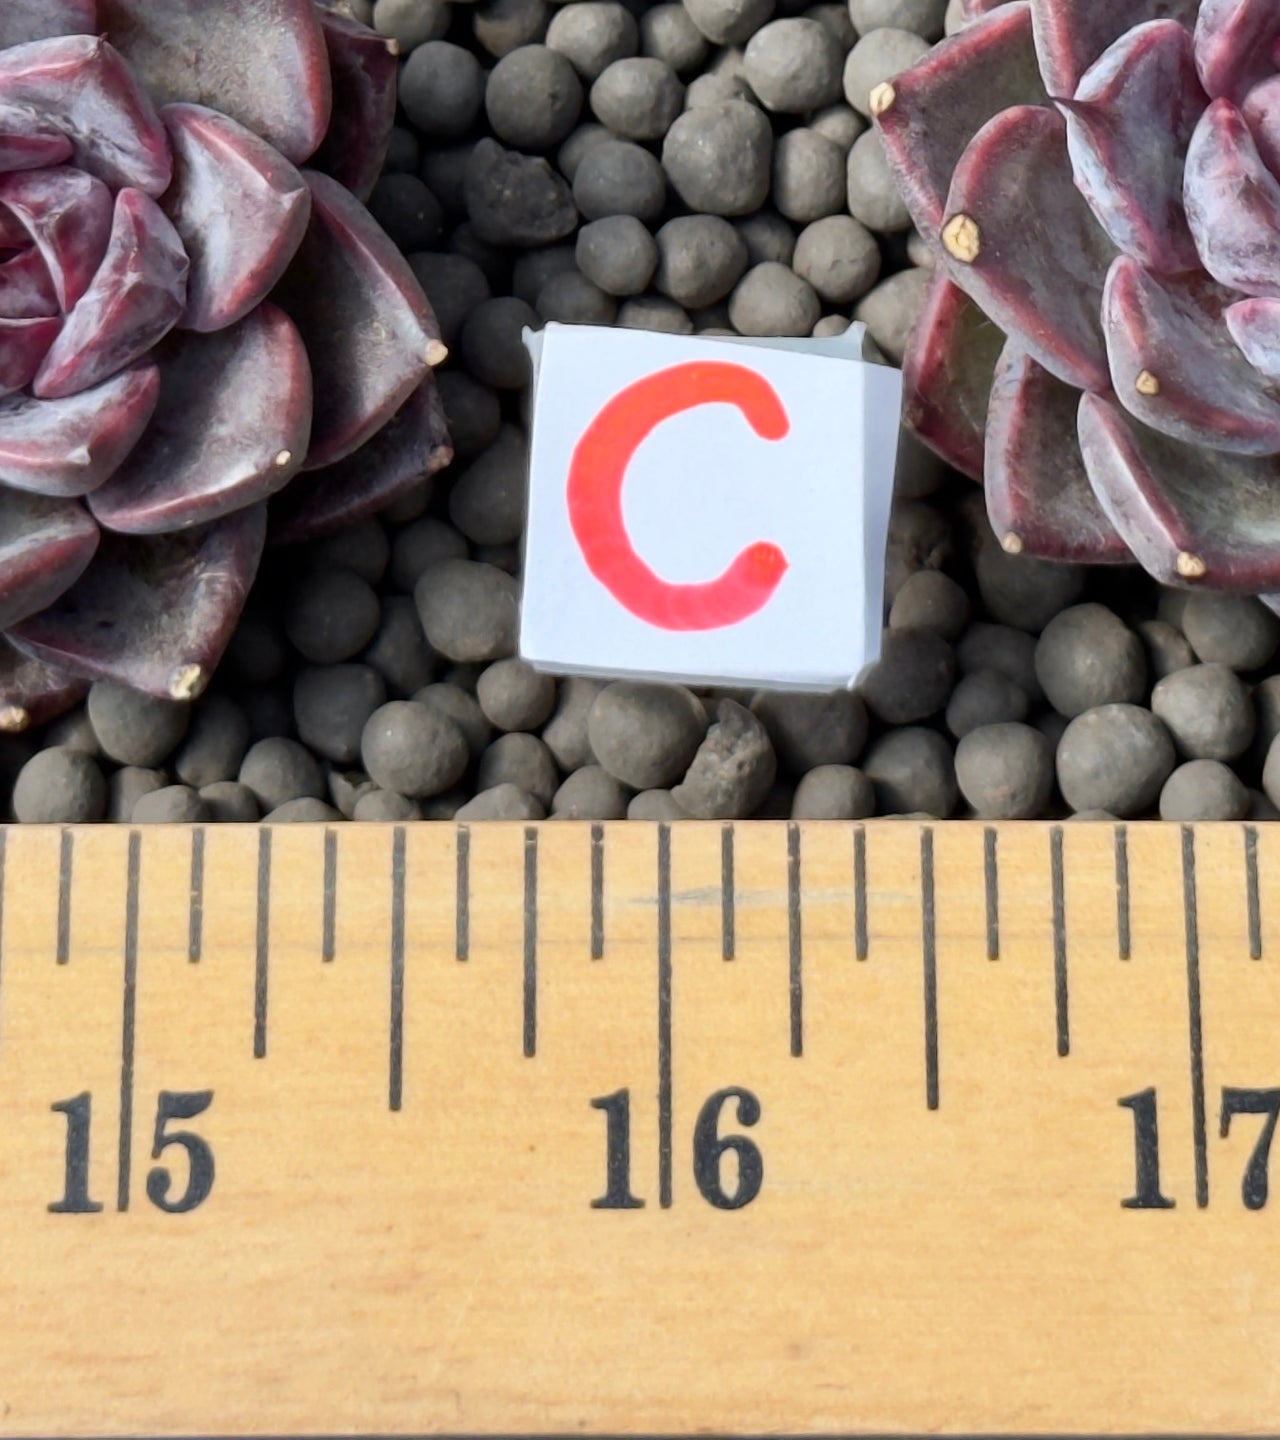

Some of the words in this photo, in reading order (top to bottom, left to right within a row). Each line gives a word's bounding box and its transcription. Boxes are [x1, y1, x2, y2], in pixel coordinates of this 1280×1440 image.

[565, 360, 791, 632] C
[46, 1090, 216, 1216] 15
[589, 1085, 765, 1212] 16
